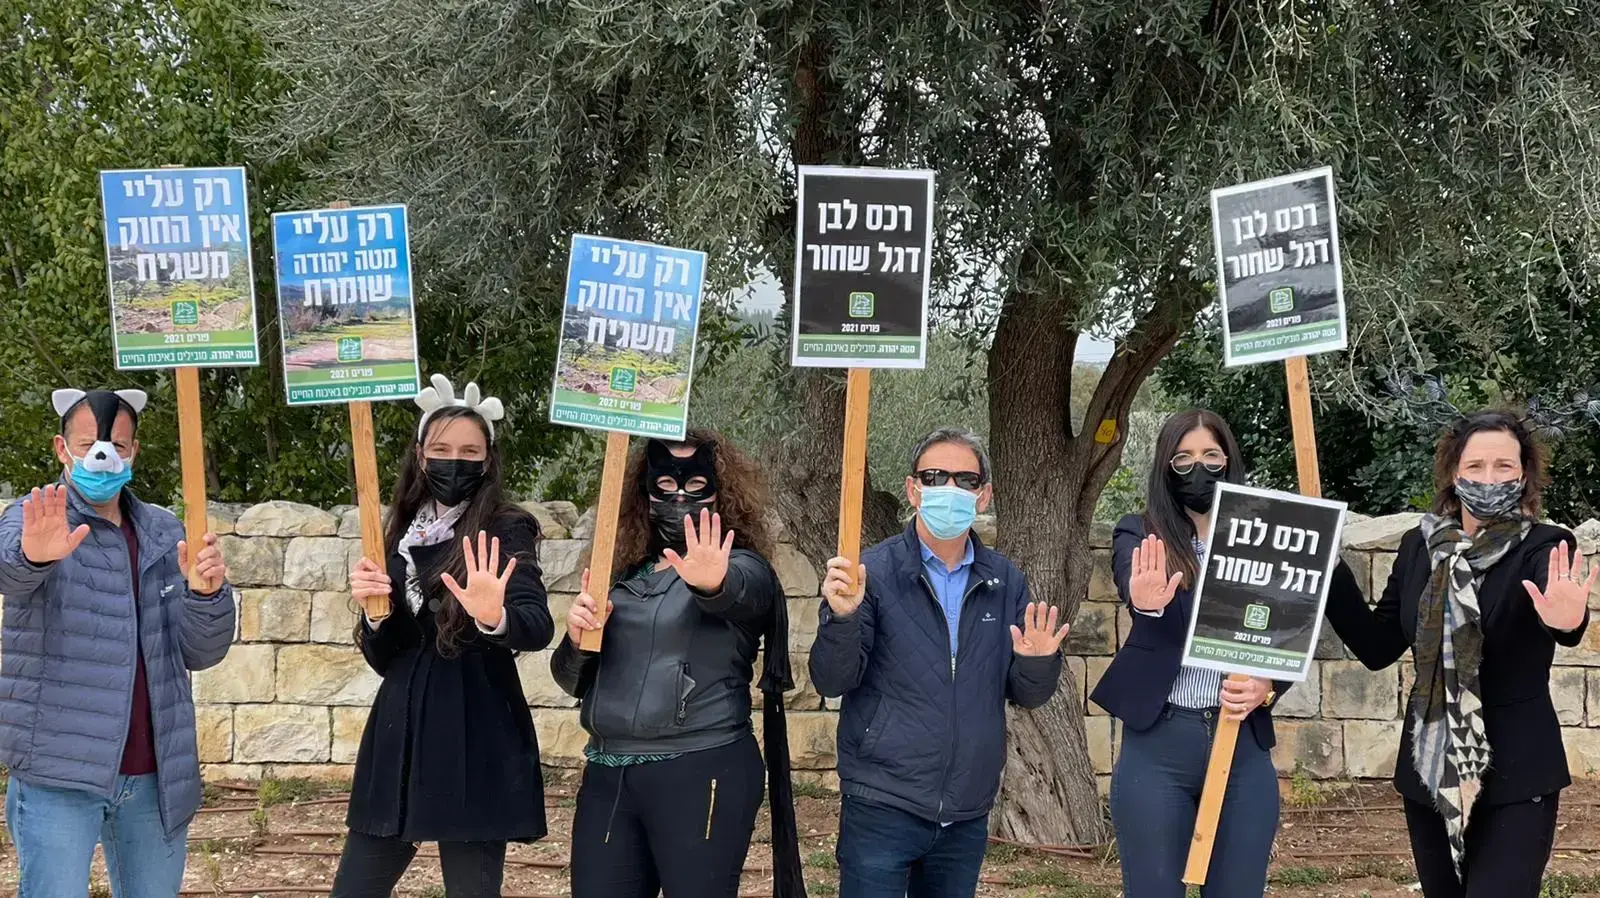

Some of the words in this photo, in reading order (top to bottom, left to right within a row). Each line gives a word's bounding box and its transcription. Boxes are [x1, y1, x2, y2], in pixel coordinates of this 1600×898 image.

[123, 175, 183, 207] עליי
[193, 177, 231, 211] רק
[818, 199, 857, 233] לבן
[866, 203, 912, 232] רכס
[1276, 203, 1317, 232] רכס
[118, 216, 190, 250] החוק
[199, 214, 241, 247] אין
[293, 212, 349, 244] עליי
[357, 213, 394, 246] רק
[1233, 210, 1268, 245] לבן
[807, 244, 870, 272] שחור
[878, 242, 920, 273] דגל
[1289, 238, 1329, 268] דגל
[293, 252, 348, 274] יהודה
[355, 248, 397, 271] מטה
[591, 245, 647, 279] עליי
[1226, 247, 1283, 278] שחור
[137, 251, 229, 281] משגיח
[654, 255, 689, 287] רק
[304, 274, 392, 306] שומרת
[577, 280, 644, 314] החוק
[653, 290, 693, 322] אין
[1266, 319, 1281, 328] 2021
[1283, 315, 1301, 326] פורים
[841, 324, 858, 332] 2021
[860, 324, 880, 332] פורים
[1322, 328, 1336, 337] מטה
[164, 335, 184, 343] 2021
[187, 333, 209, 342] פורים
[587, 316, 675, 353] משגיח
[1276, 334, 1300, 344] מובילים
[803, 343, 823, 352] החיים
[825, 344, 848, 352] באיכות
[850, 344, 875, 352] מובילים
[1235, 342, 1253, 351] החיים
[1254, 339, 1275, 348] באיכות
[122, 354, 145, 363] החיים
[148, 353, 175, 361] באיכות
[178, 351, 207, 360] מובילים
[236, 351, 253, 359] מטה
[330, 370, 349, 378] 2021
[352, 368, 373, 377] פורים
[316, 388, 341, 397] באיכות
[343, 386, 371, 396] מובילים
[398, 383, 415, 392] מטה
[292, 390, 313, 399] החיים
[599, 398, 617, 407] 2021
[620, 401, 641, 410] פורים
[556, 409, 578, 419] החיים
[580, 412, 605, 424] באיכות
[608, 416, 636, 428] מובילים
[663, 424, 680, 433] מטה
[1227, 517, 1268, 546] לבן
[1273, 525, 1319, 555] רכס
[1213, 554, 1273, 586] שחור
[1280, 561, 1322, 594] דגל
[1234, 632, 1250, 641] 2021
[1252, 635, 1271, 644] פורים
[1195, 645, 1214, 656] החיים
[1216, 649, 1238, 659] באיכות
[1240, 652, 1264, 663] מובילים
[1287, 659, 1300, 667] מטה
